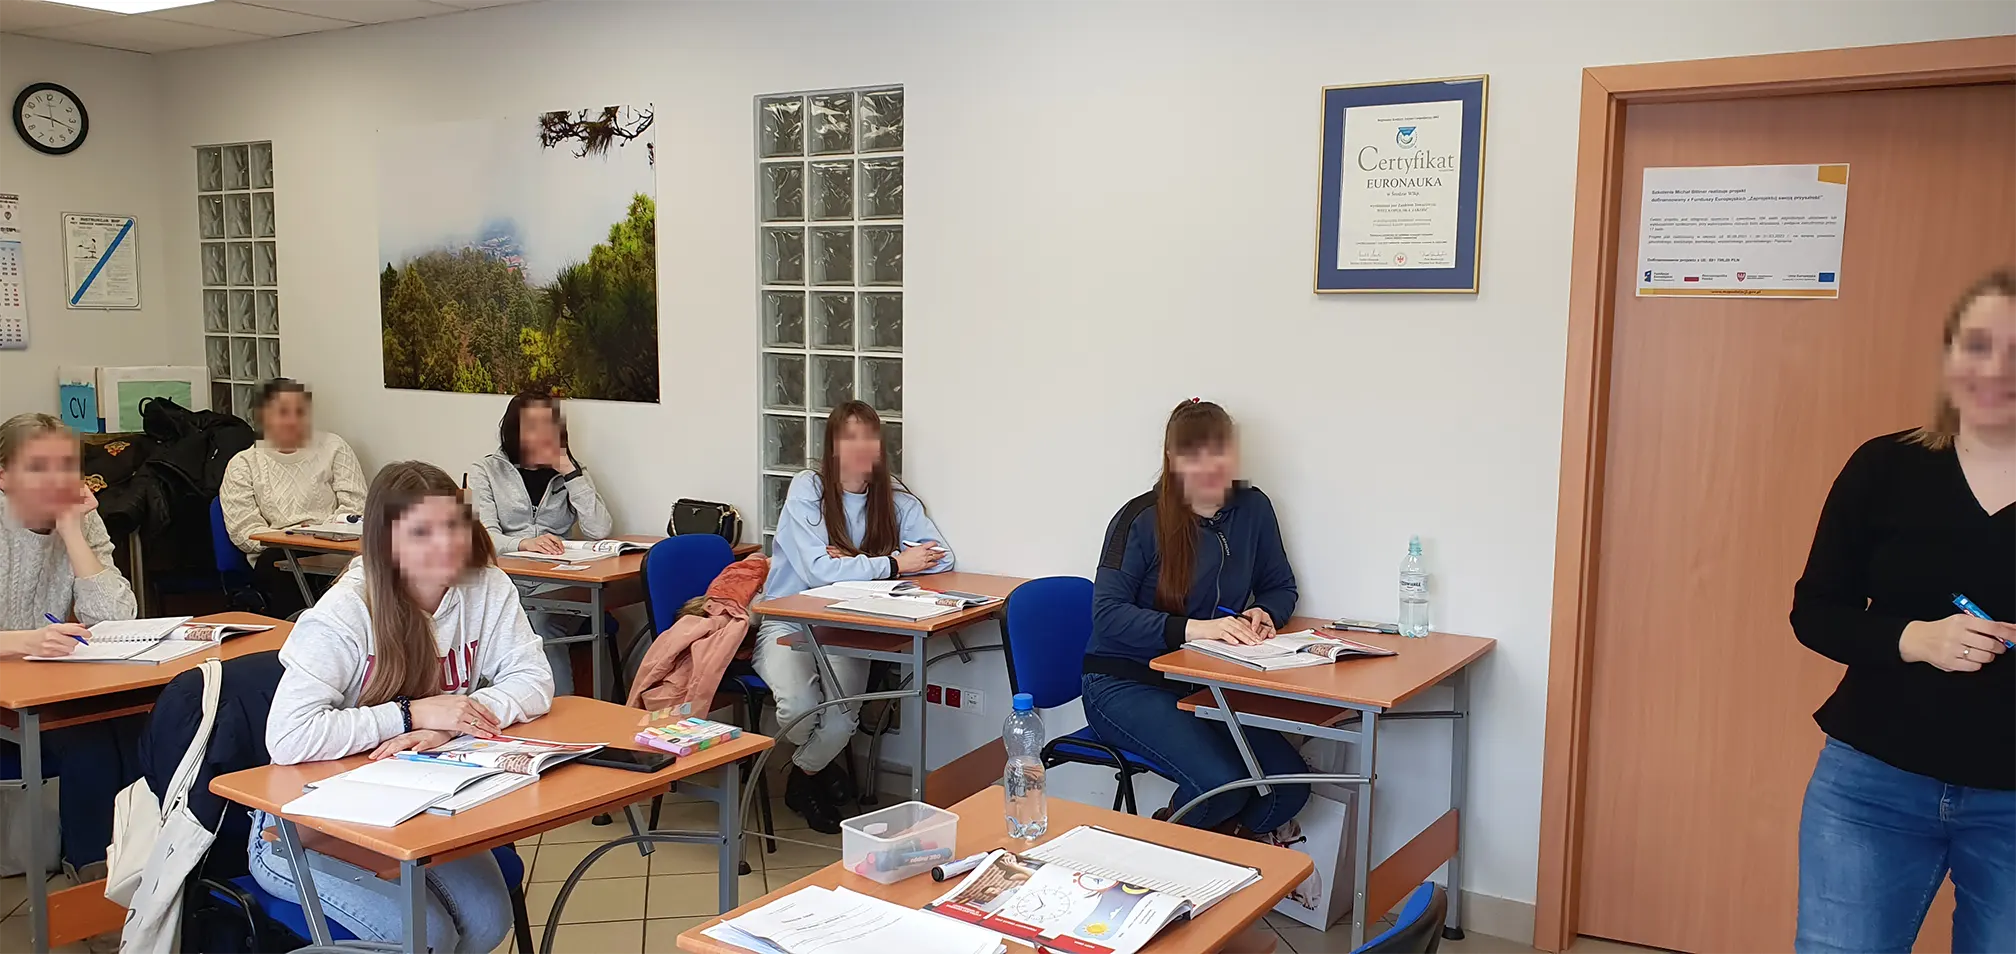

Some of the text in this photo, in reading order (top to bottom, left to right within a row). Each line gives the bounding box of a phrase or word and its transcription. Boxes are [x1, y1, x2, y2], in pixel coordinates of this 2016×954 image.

[59, 134, 66, 142] 5
[1358, 145, 1455, 175] Certyfikat
[1367, 177, 1443, 189] EURONAUKA
[69, 397, 87, 419] CV
